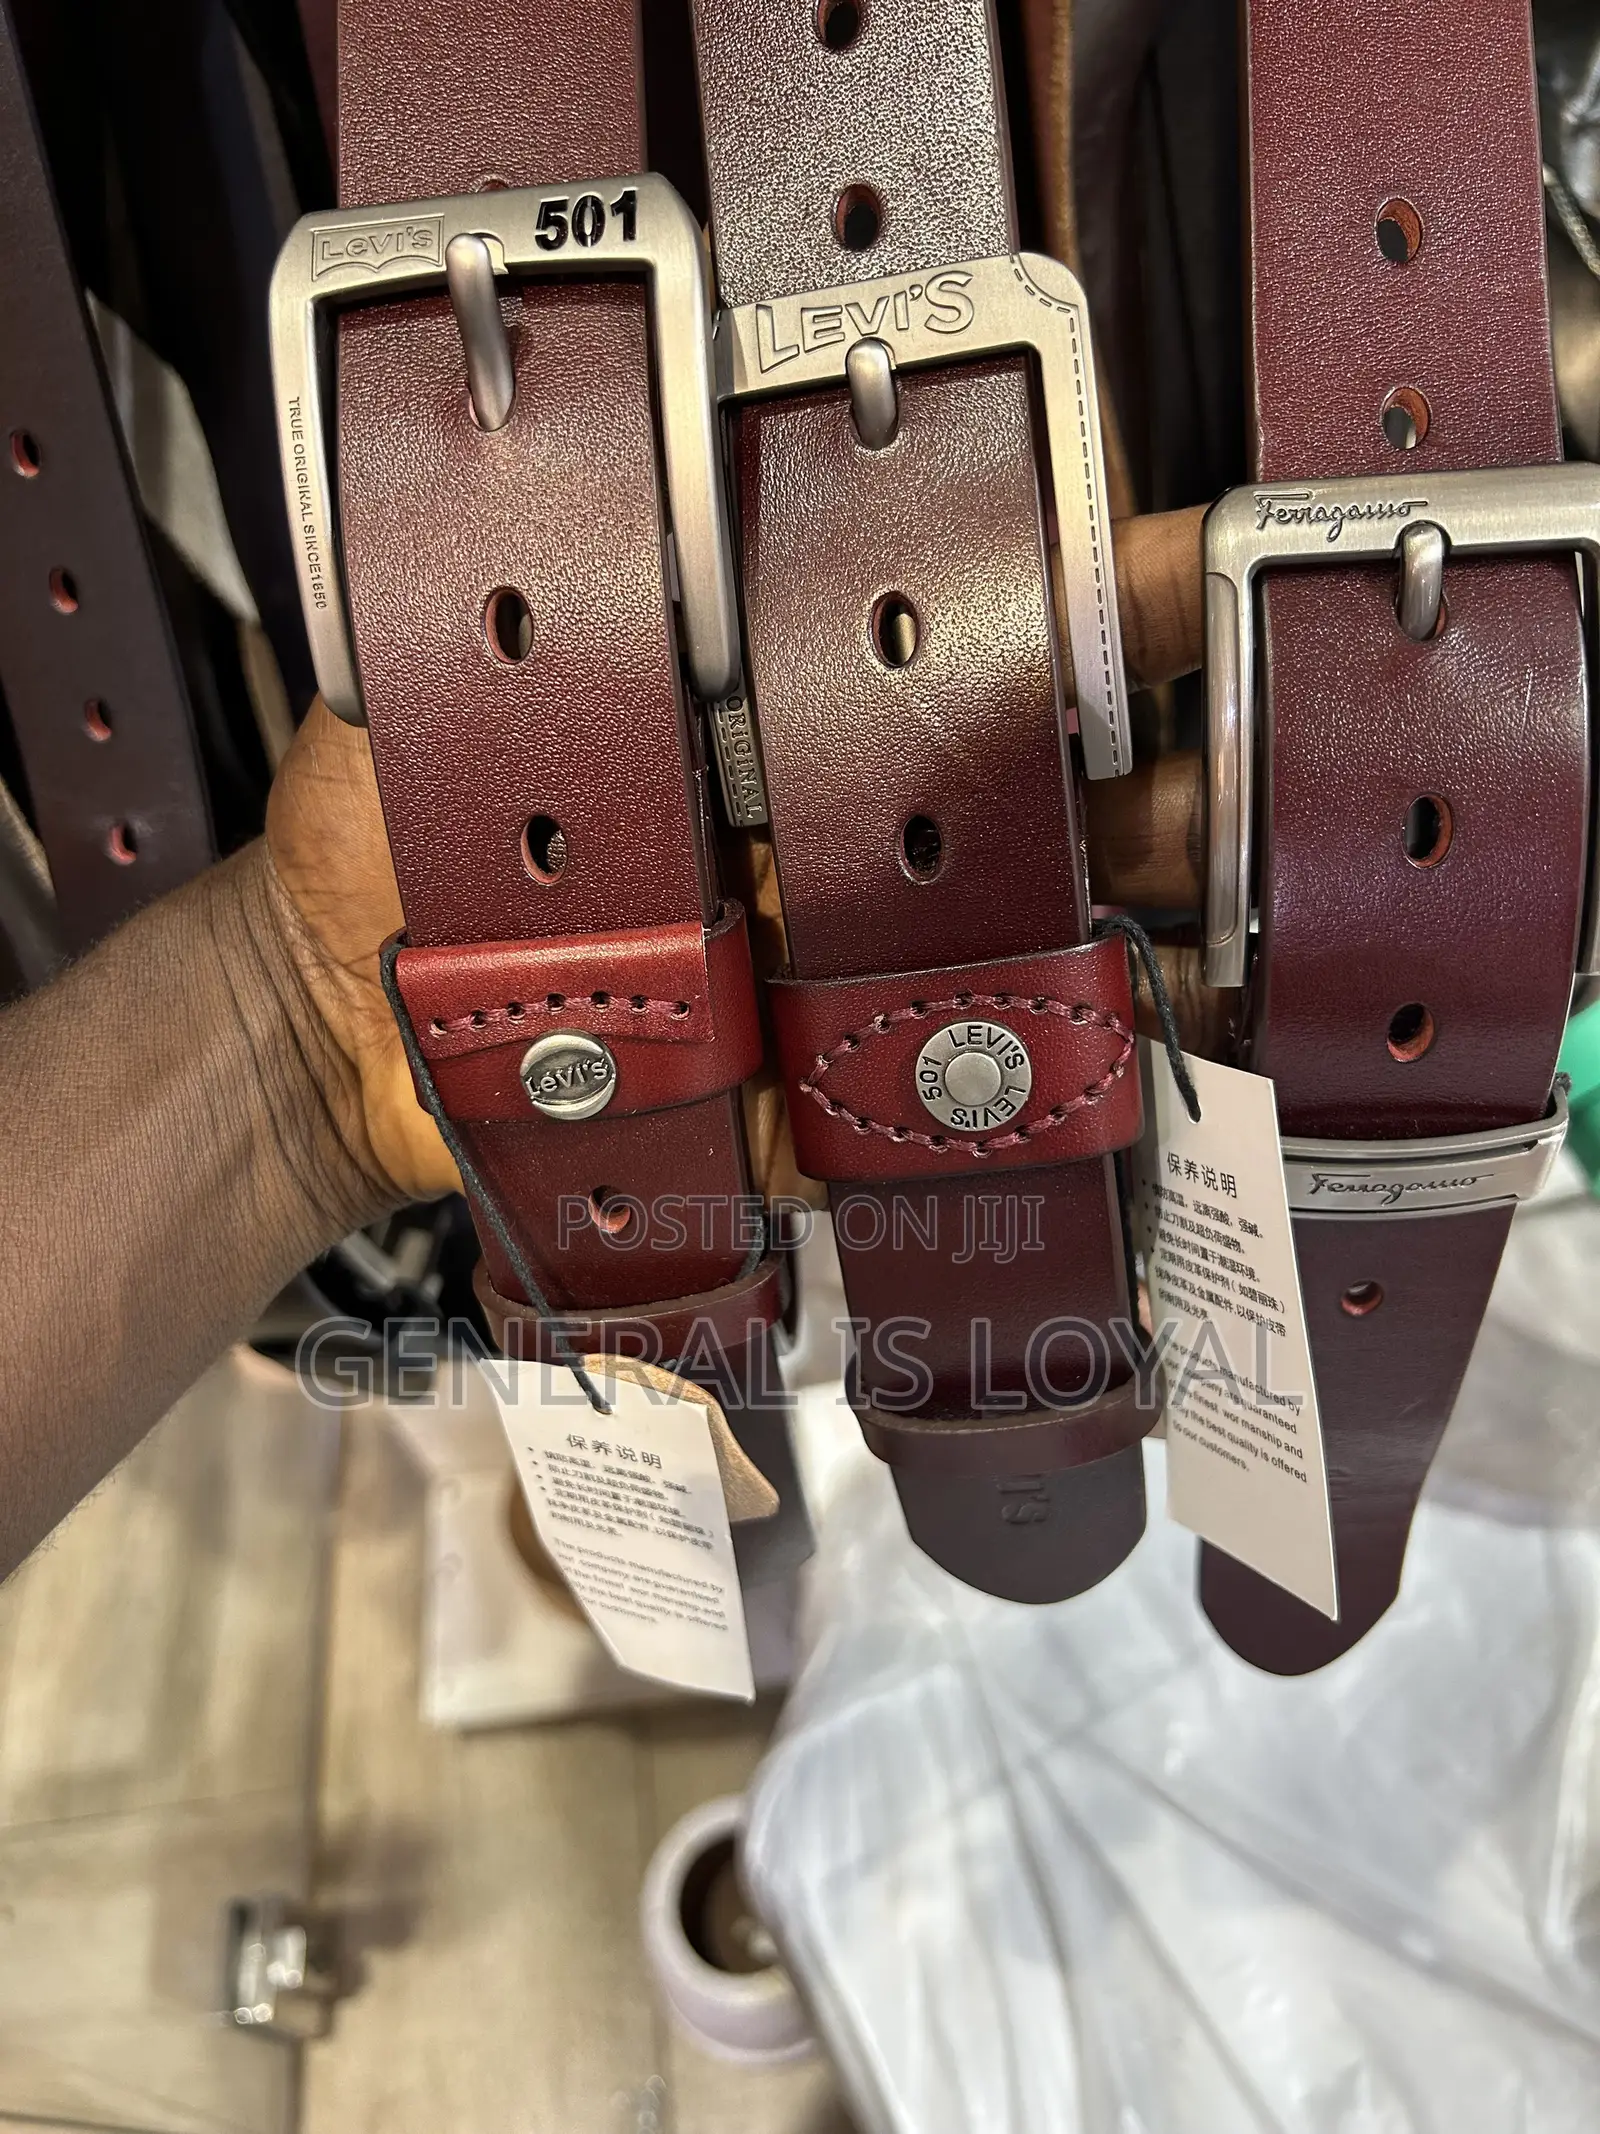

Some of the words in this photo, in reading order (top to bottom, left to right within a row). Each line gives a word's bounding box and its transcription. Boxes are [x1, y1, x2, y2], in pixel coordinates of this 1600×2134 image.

[534, 189, 640, 251] 501
[755, 270, 975, 374] LEVI'S
[289, 396, 304, 440] TRUE
[948, 1025, 1025, 1070] LEVI'S
[919, 1056, 942, 1101] 501
[951, 1085, 1026, 1128] LEVI'S
[1167, 1151, 1238, 1199] 保养说明
[1220, 1366, 1286, 1407] manufactured
[1288, 1397, 1301, 1416] by
[567, 1433, 663, 1470] 保养说明
[1227, 1431, 1260, 1457] quality
[1260, 1447, 1270, 1462] is
[1271, 1455, 1308, 1484] offered
[1284, 1441, 1304, 1460] and
